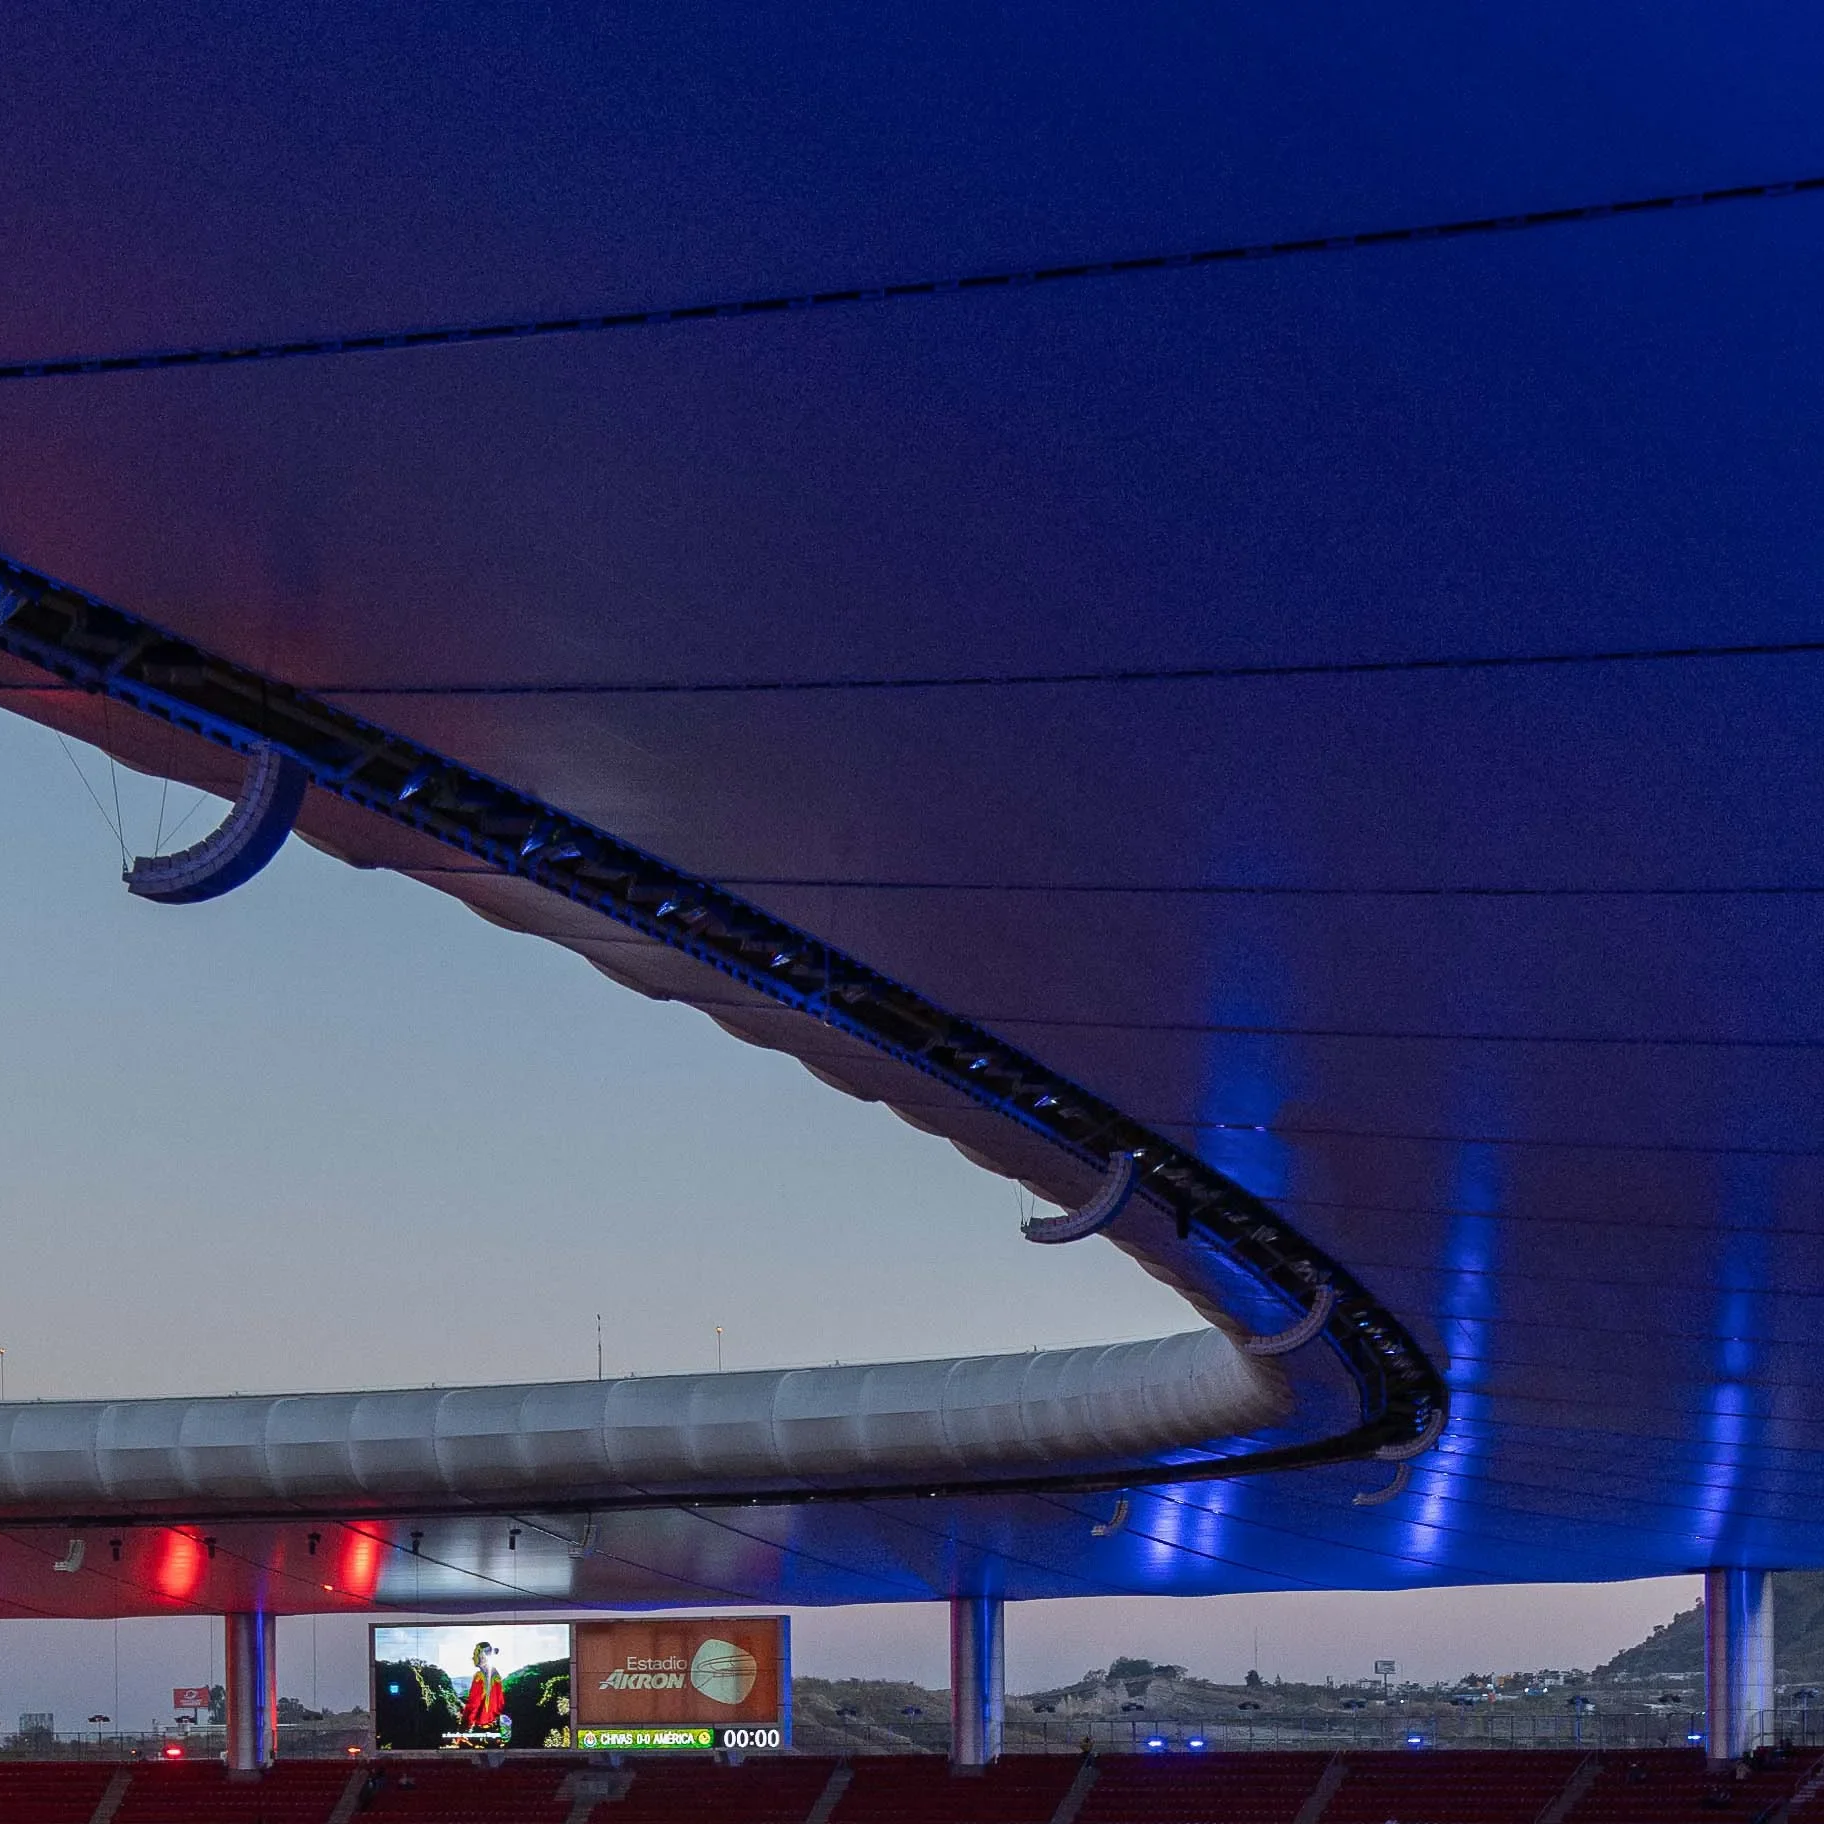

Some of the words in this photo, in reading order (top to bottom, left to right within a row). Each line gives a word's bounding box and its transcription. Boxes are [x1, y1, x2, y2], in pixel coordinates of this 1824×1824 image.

[627, 1656, 687, 1671] Estadio
[599, 1669, 686, 1690] AKRON
[600, 1734, 632, 1745] CHIVAS
[637, 1734, 651, 1744] 0-0
[653, 1732, 695, 1745] AMÉRICA
[723, 1729, 780, 1748] 00:00
